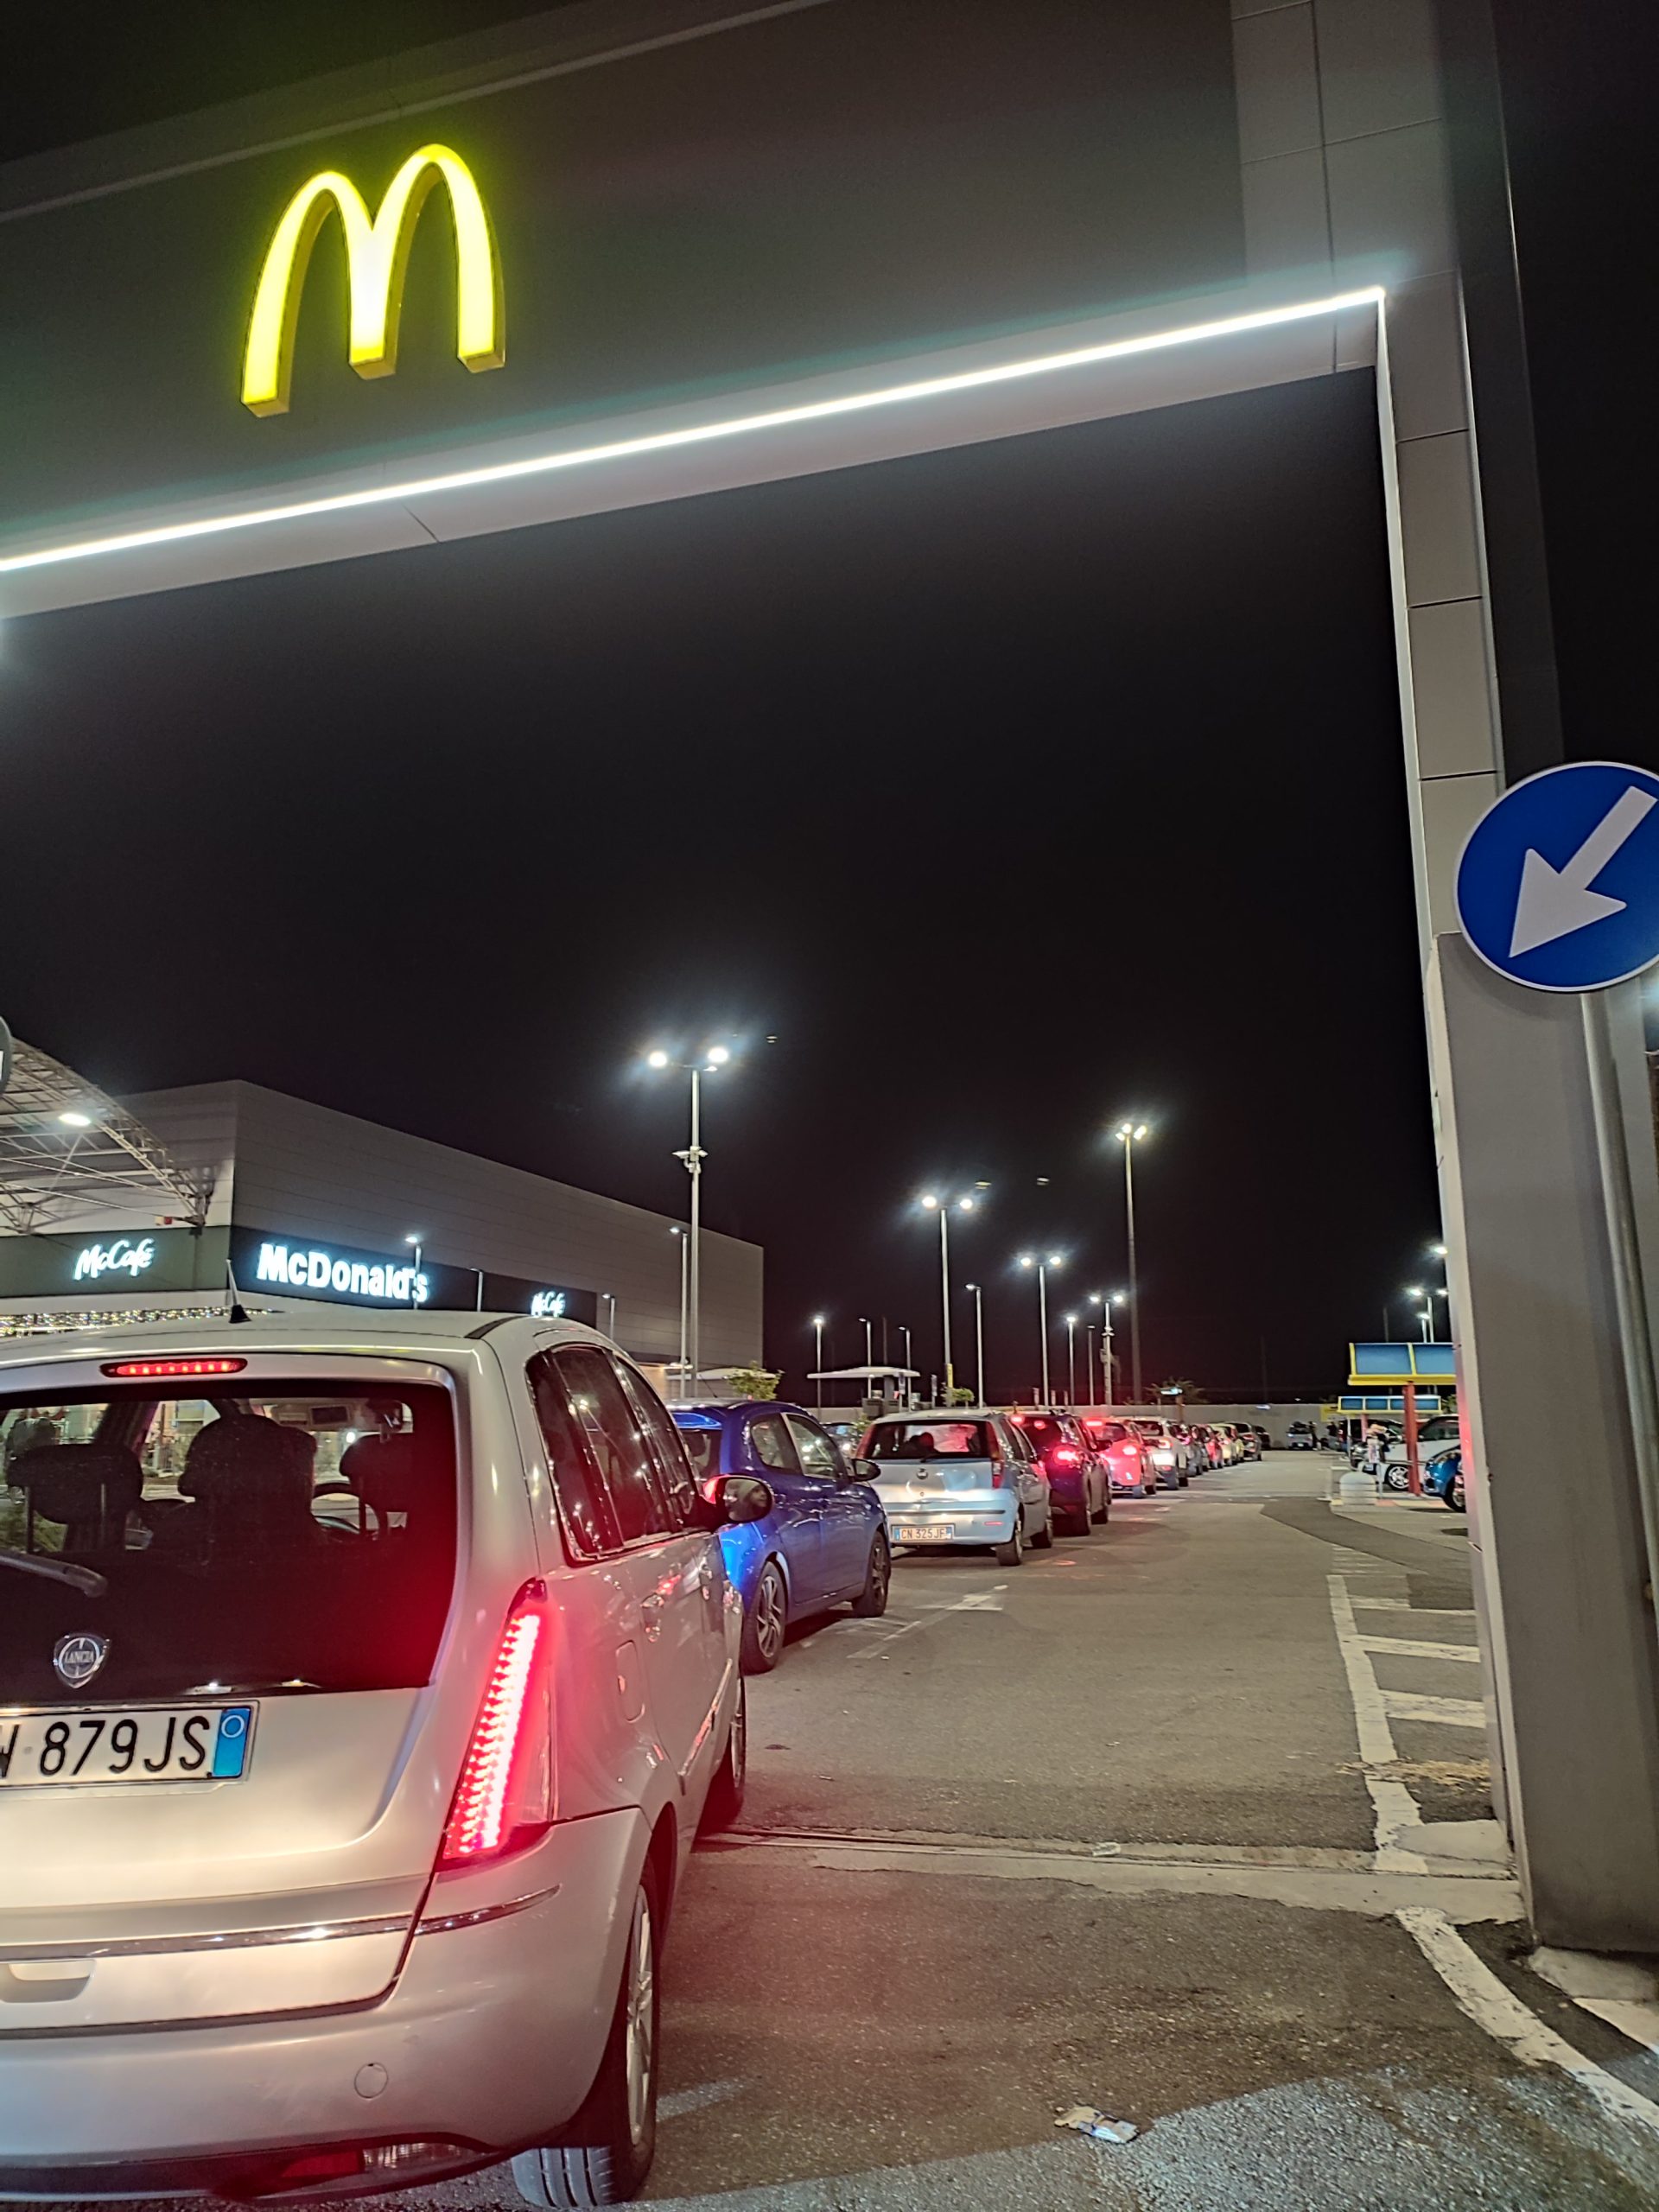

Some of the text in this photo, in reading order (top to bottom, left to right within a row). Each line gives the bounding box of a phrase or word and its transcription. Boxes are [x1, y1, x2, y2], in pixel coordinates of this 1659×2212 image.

[257, 1243, 429, 1303] McDonald's
[64, 1650, 94, 1664] LANCIA
[40, 1715, 210, 1777] 879JS
